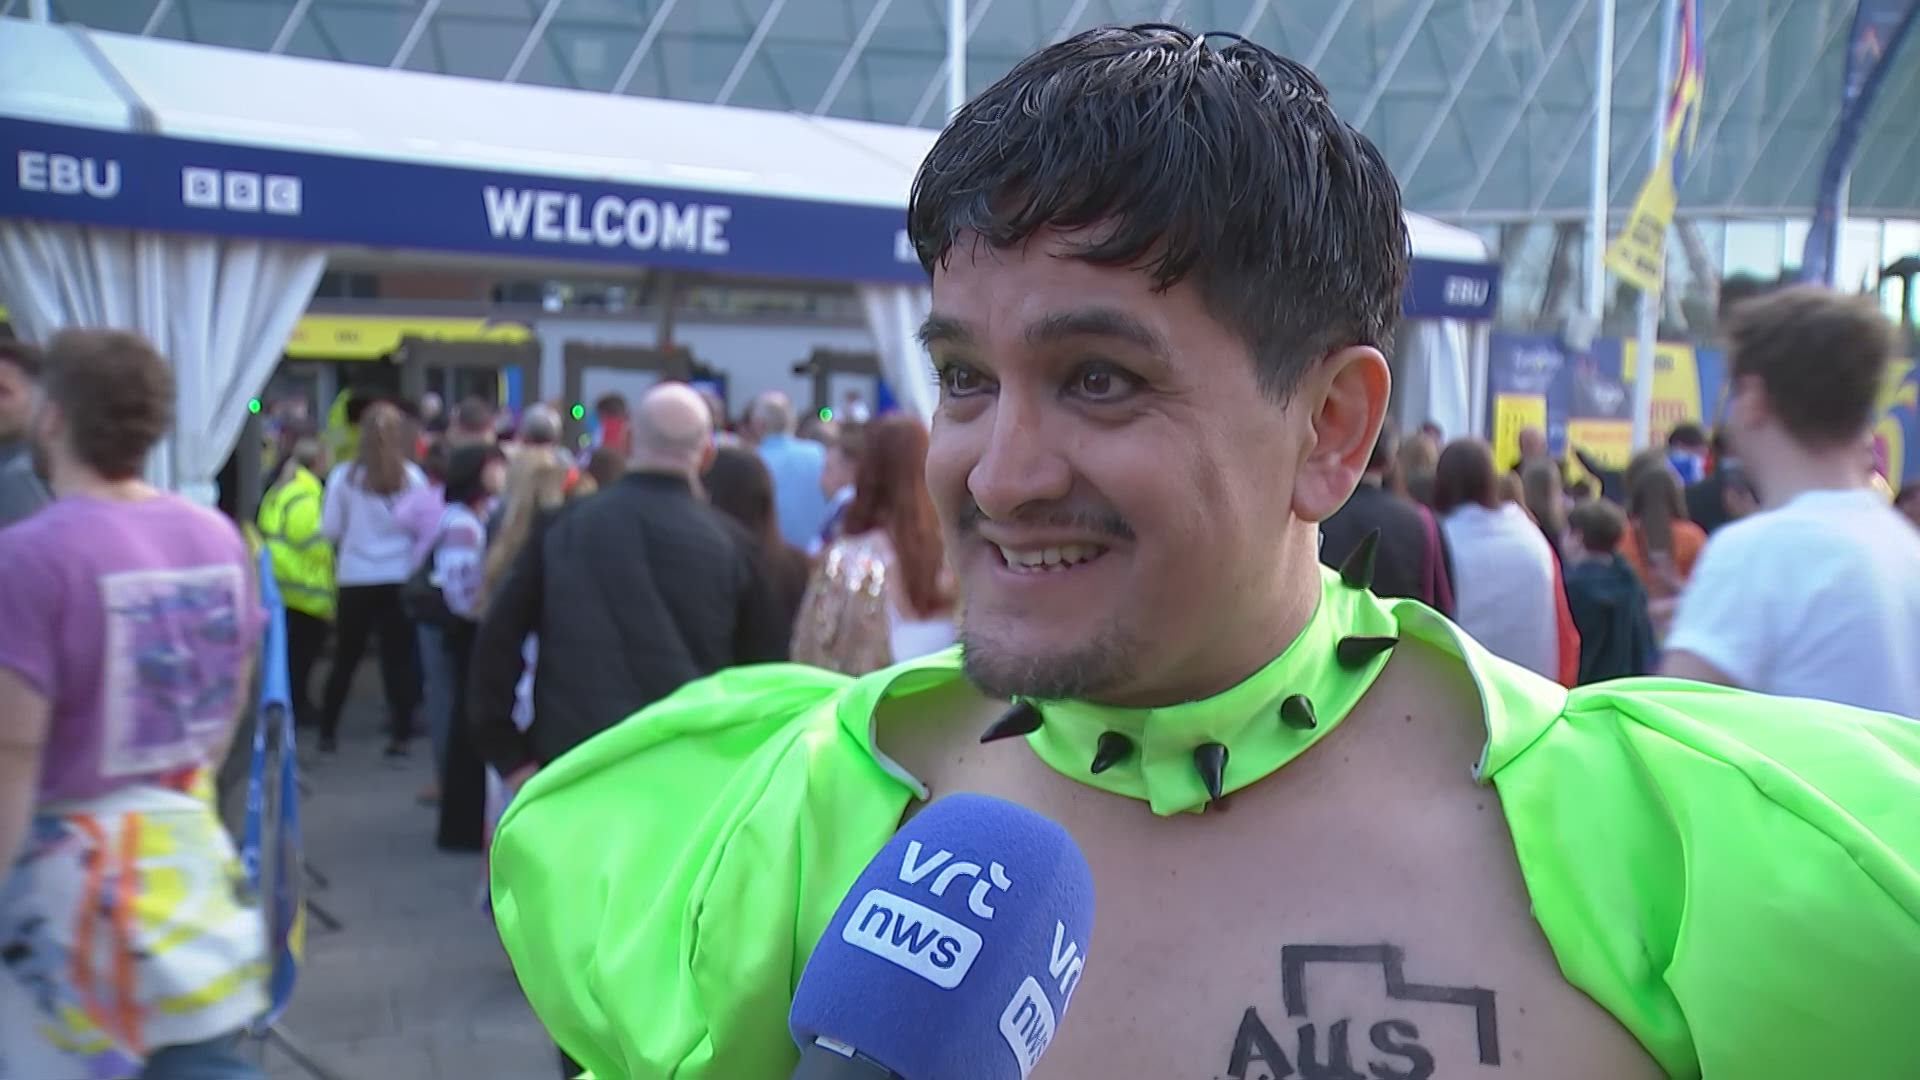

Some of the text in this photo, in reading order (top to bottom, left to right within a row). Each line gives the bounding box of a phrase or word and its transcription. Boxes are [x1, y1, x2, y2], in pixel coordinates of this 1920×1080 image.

[18, 150, 120, 197] EBU
[183, 168, 301, 215] BBC
[484, 187, 731, 253] WELCOME
[1444, 275, 1489, 307] EBU
[898, 840, 1013, 920] vrt
[858, 903, 962, 970] nws
